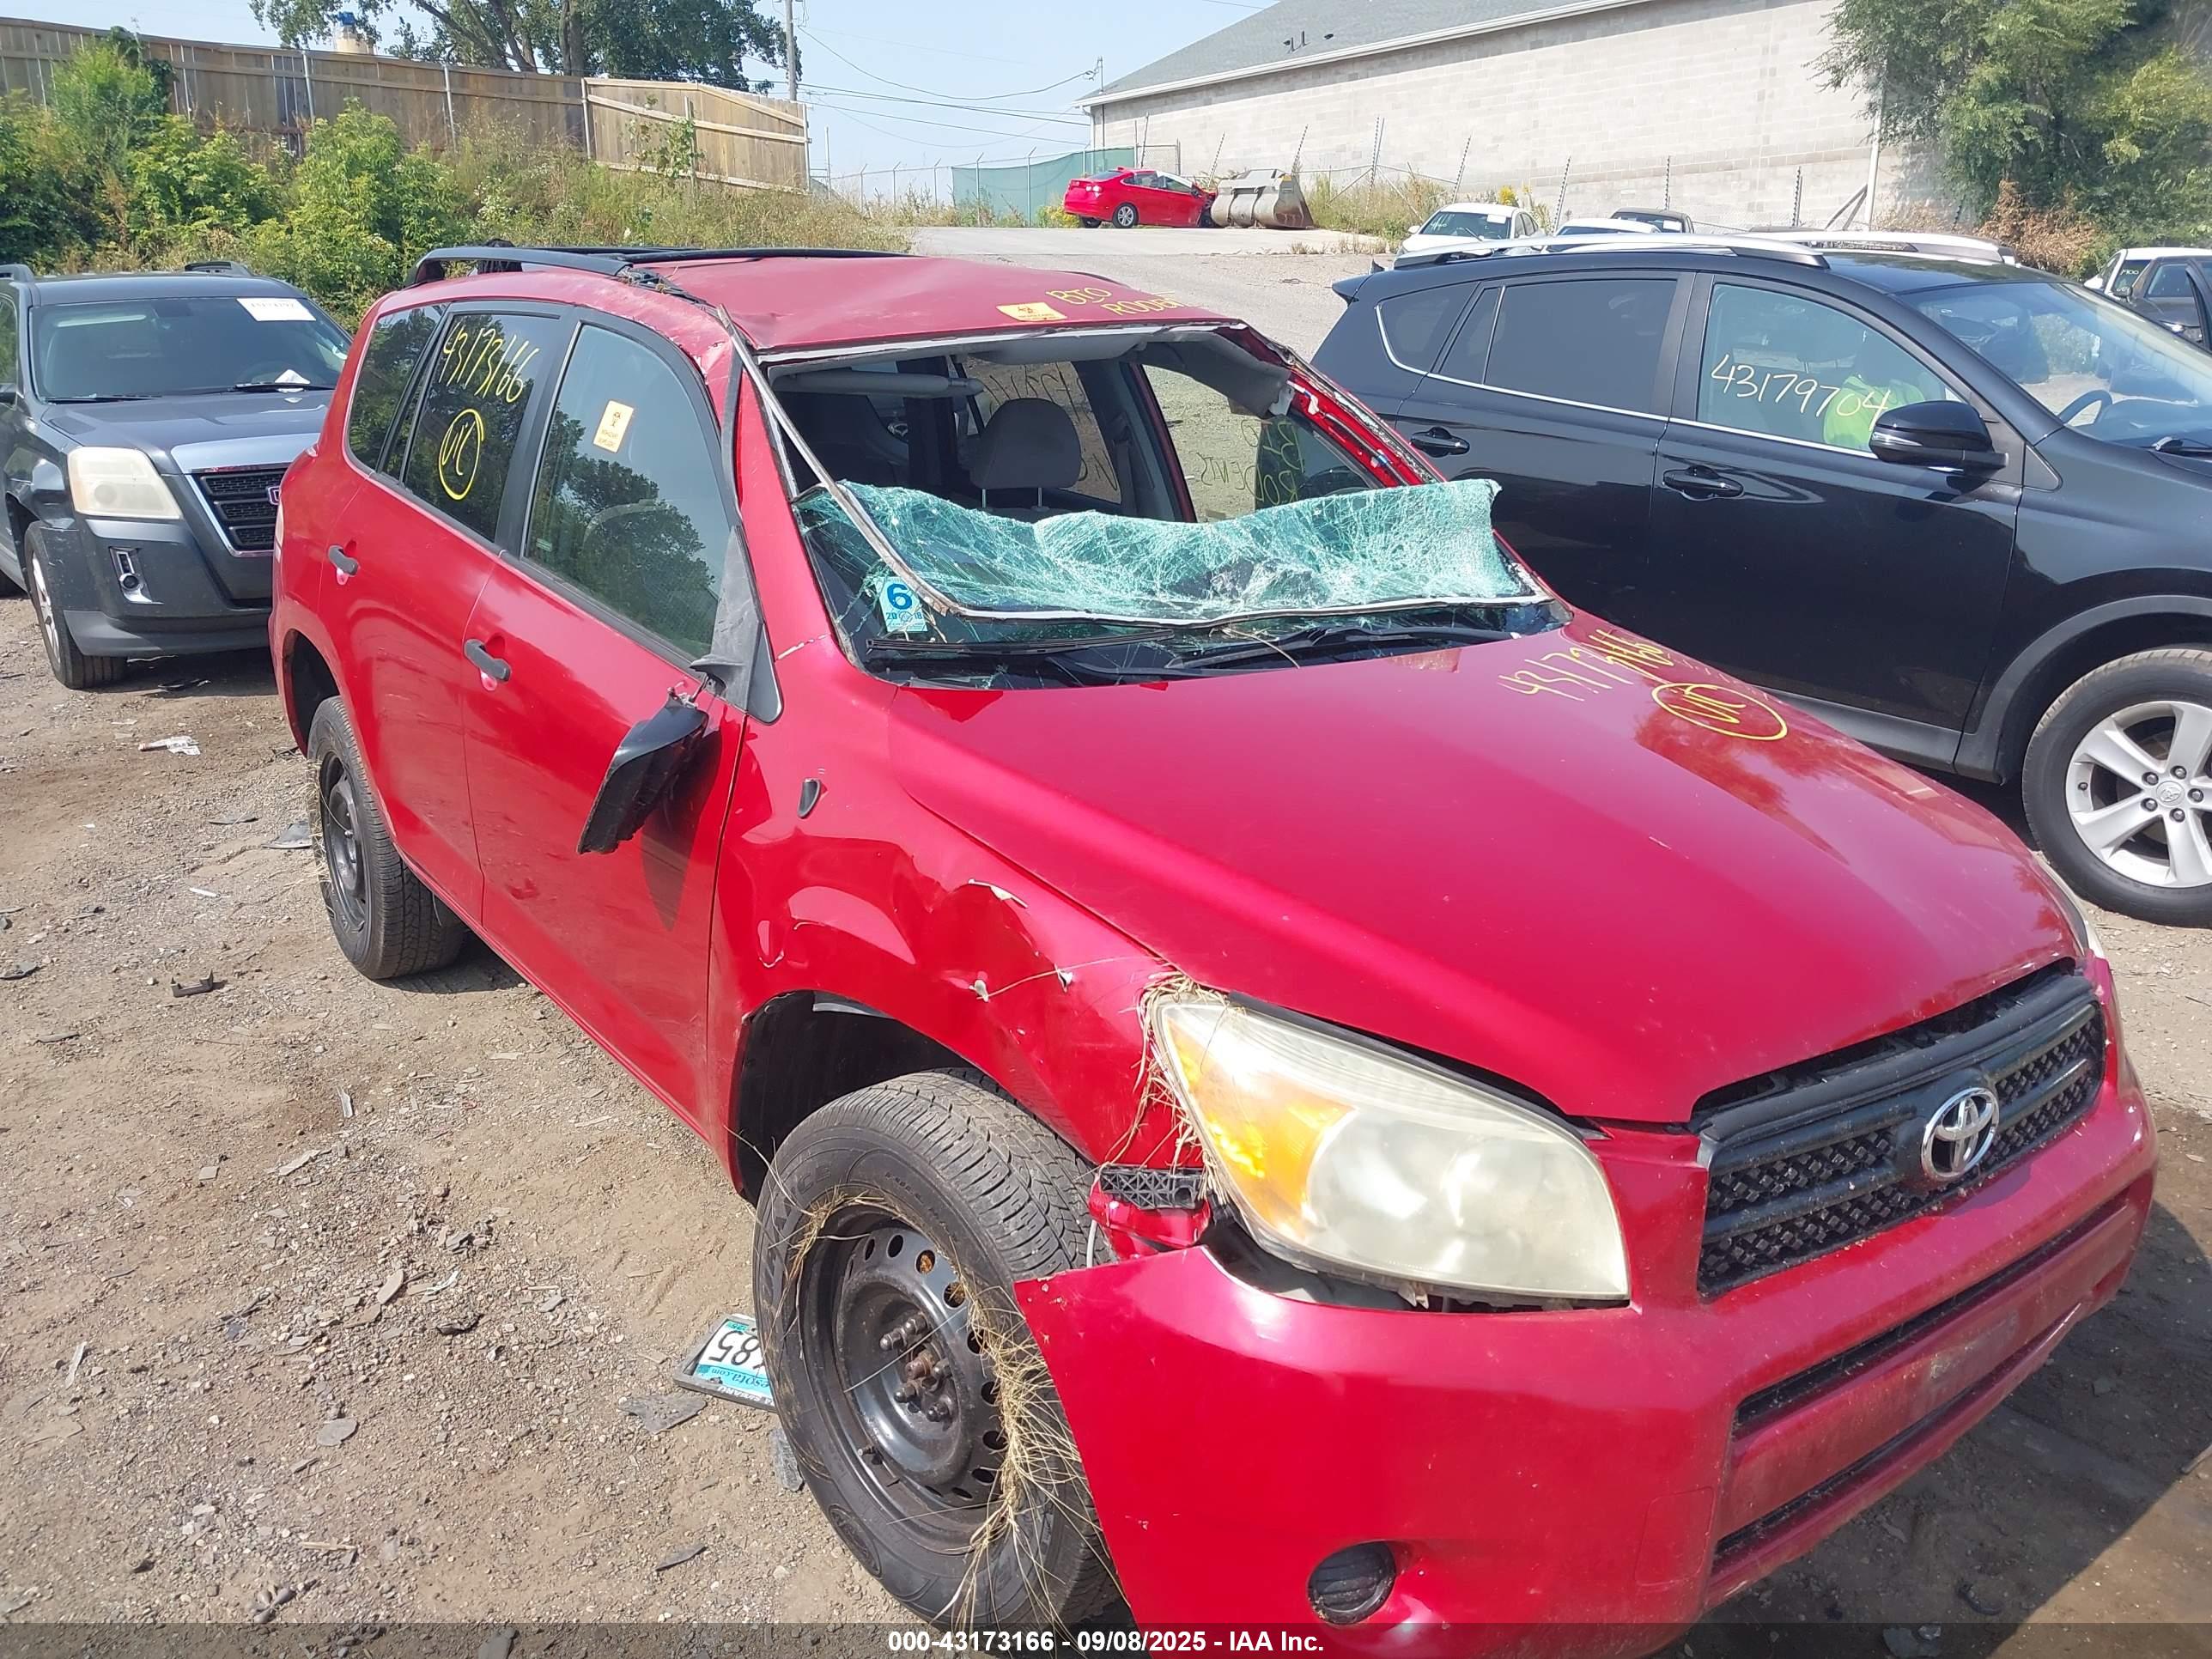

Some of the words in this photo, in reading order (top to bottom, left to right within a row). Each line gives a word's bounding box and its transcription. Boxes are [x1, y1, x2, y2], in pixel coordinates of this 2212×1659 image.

[438, 321, 540, 403] 43173166
[1711, 353, 1892, 432] 43179704
[887, 583, 913, 610] 6
[708, 1330, 766, 1370] 85
[712, 1367, 770, 1388] esota.com
